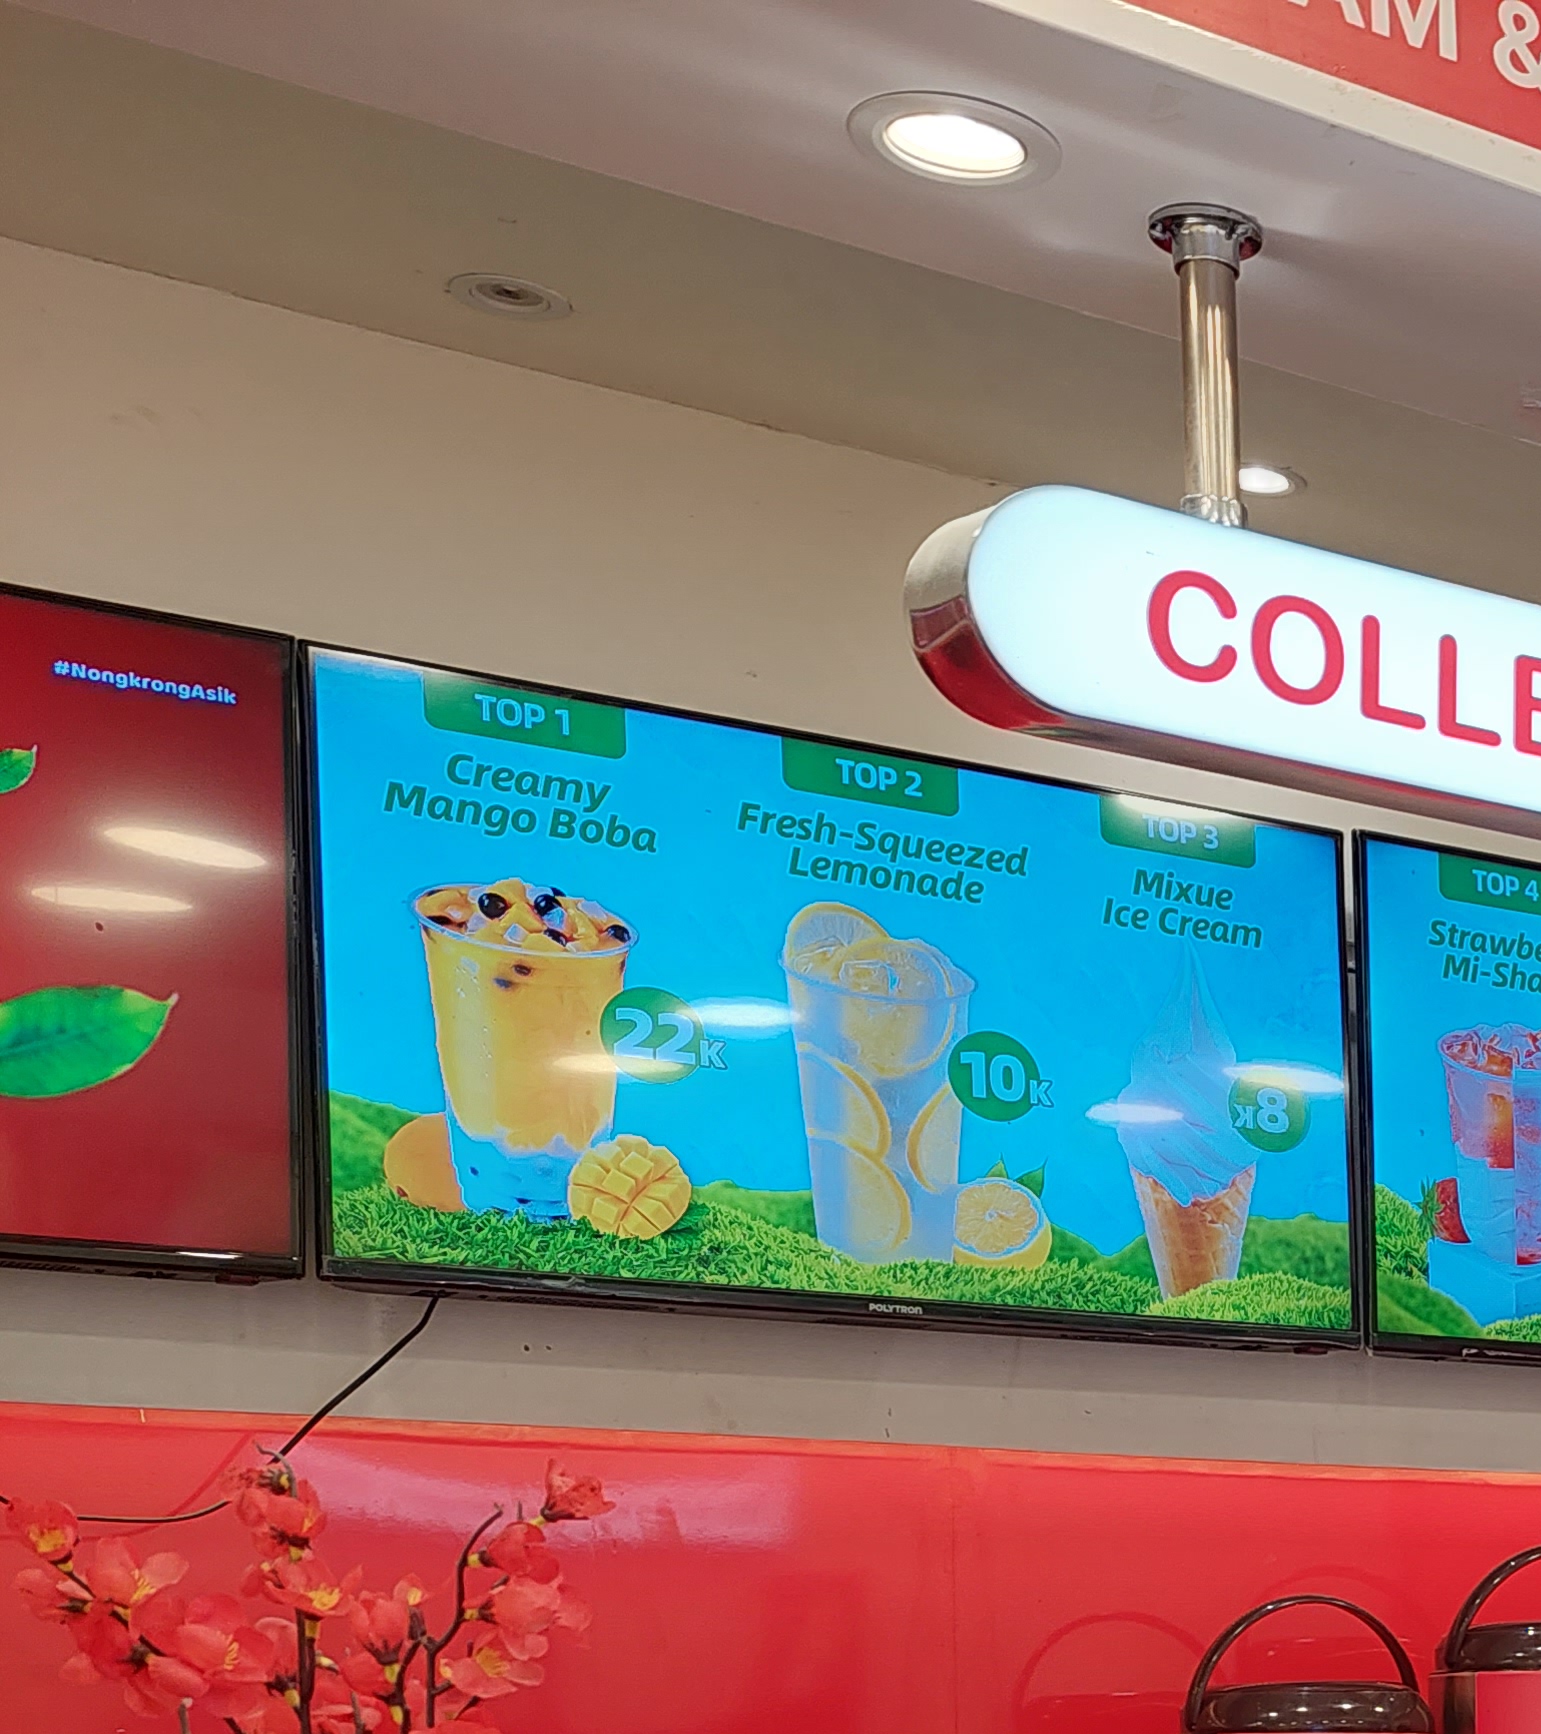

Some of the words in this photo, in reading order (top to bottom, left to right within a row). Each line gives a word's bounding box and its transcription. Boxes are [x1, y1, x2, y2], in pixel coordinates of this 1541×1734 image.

[53, 659, 237, 705] #NongkrongAsik
[474, 692, 546, 730] TOP
[553, 709, 571, 736] 1
[446, 752, 612, 812] Creamy
[835, 757, 899, 793] TOP
[905, 771, 923, 798] 2
[383, 780, 539, 842] Mango
[547, 806, 659, 854] Boba
[737, 802, 1029, 877] Fresh-Squeezed
[1142, 814, 1198, 846] TOP
[1202, 825, 1219, 849] 3
[788, 846, 985, 905] Lemonade
[1133, 868, 1234, 912] Mixue
[1472, 869, 1520, 898] TOP
[1523, 879, 1540, 902] 4
[1102, 898, 1150, 931] Ice
[1157, 905, 1263, 949] Cream
